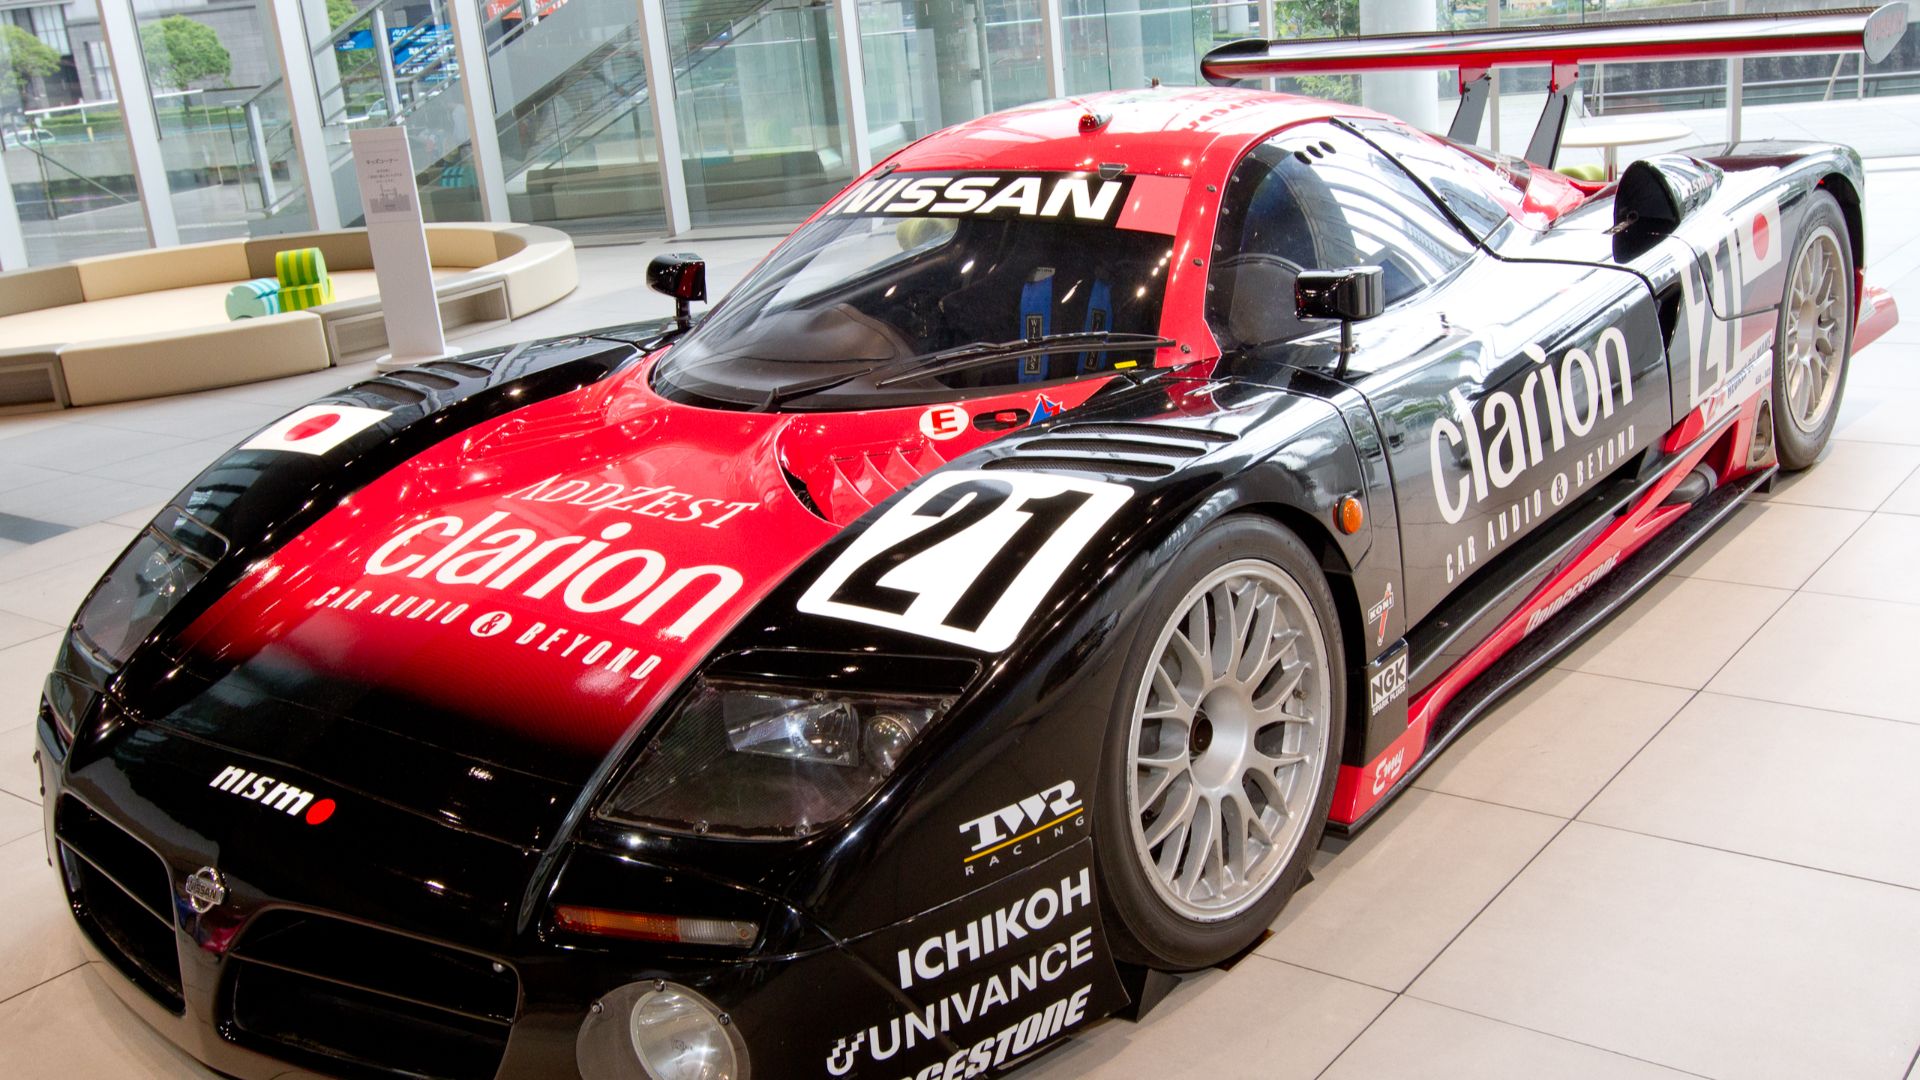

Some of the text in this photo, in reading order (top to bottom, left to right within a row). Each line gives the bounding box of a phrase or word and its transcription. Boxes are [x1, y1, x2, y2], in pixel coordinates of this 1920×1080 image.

[826, 177, 1122, 220] NISSAN
[1689, 233, 1736, 398] 21
[931, 408, 957, 435] E
[1431, 327, 1633, 524] clarion
[502, 473, 760, 529] ADDZEST
[1446, 424, 1635, 583] CAR AUDIO & BEYOND
[364, 510, 744, 641] clarion
[827, 479, 1094, 632] 21
[312, 585, 662, 680] CAR AUDIO & BEYOND
[1369, 592, 1393, 620] KONI
[1371, 655, 1406, 708] NGK
[1372, 683, 1406, 717] SPARK PLUGS
[959, 780, 1082, 852] TWR
[965, 816, 1084, 876] RACING
[187, 877, 218, 899] NISSAN
[898, 867, 1092, 989] ICHIKOH
[868, 926, 1094, 1061] UNIVANCE
